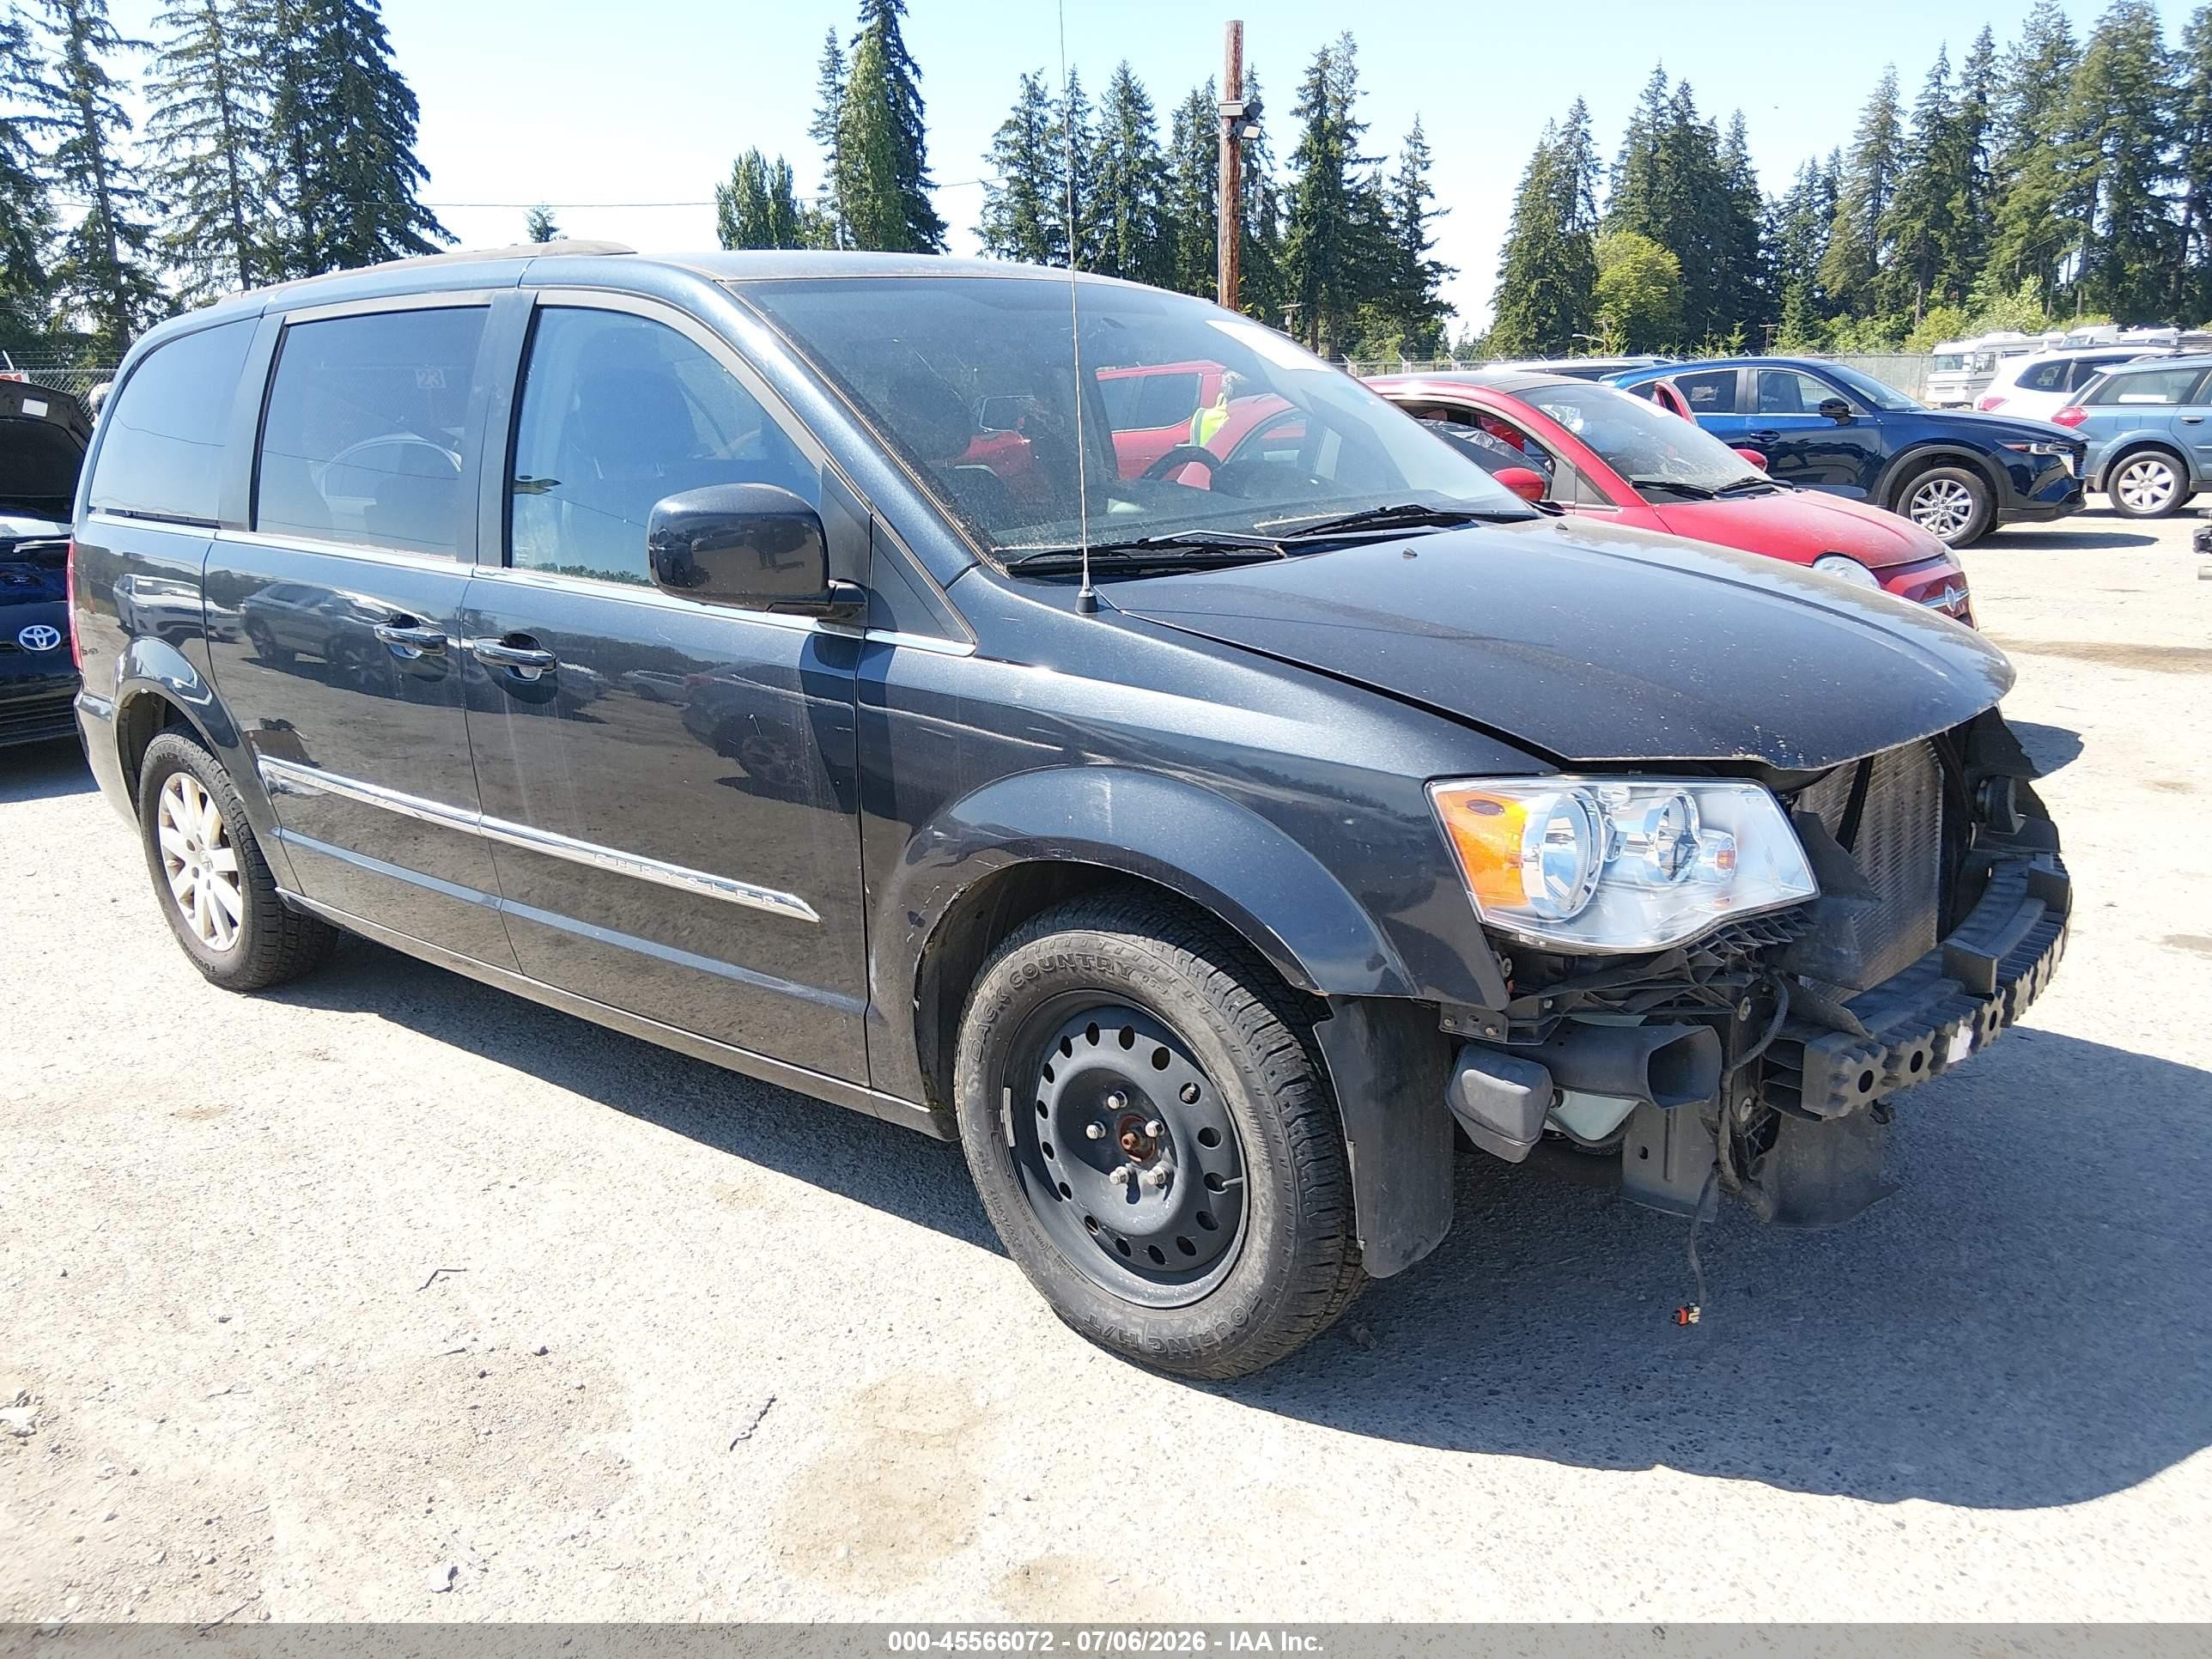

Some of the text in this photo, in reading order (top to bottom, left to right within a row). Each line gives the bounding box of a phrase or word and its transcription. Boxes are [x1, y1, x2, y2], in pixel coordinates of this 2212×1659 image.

[593, 853, 775, 908] CHRYSLER
[1009, 952, 1135, 989] COUNTRY
[1147, 1291, 1263, 1354] TOURING
